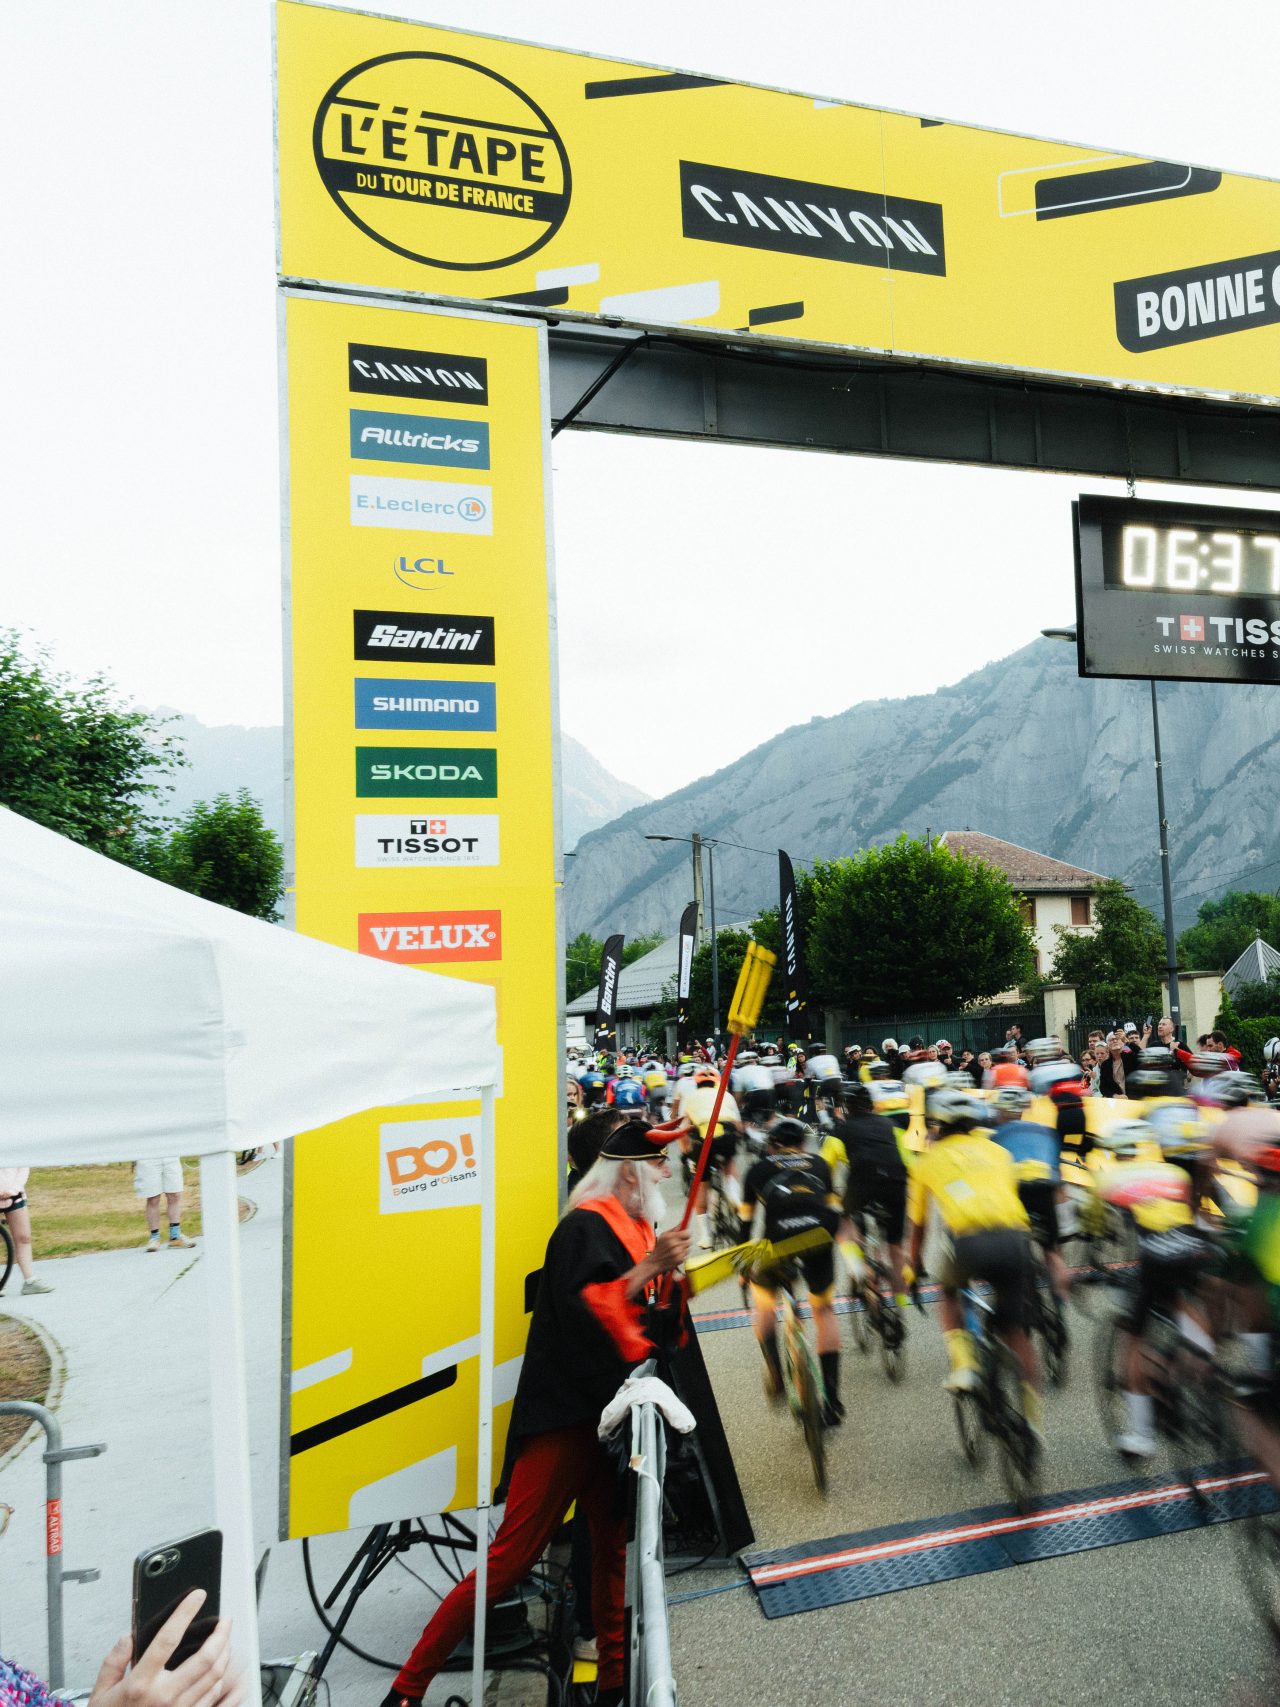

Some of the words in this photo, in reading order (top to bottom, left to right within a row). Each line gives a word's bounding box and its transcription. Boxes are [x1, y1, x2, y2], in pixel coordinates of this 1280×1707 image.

[356, 171, 377, 190] DU
[380, 172, 432, 198] TOUR
[435, 182, 459, 202] DE
[462, 185, 534, 214] FRANCE
[688, 182, 939, 257] CANYON
[1136, 268, 1266, 338] BONNE
[352, 359, 484, 390] CANYON
[360, 427, 481, 453] Alltricks
[356, 494, 455, 516] E.Leclerc
[400, 556, 455, 575] LCL
[367, 624, 483, 651] Santini
[1153, 644, 1196, 655] SWISS
[1203, 647, 1265, 658] WATCHES
[373, 697, 480, 713] SHIMANO
[377, 837, 479, 854] TISSOT
[392, 1182, 427, 1197] Bourg
[430, 1170, 477, 1187] d'Oisans
